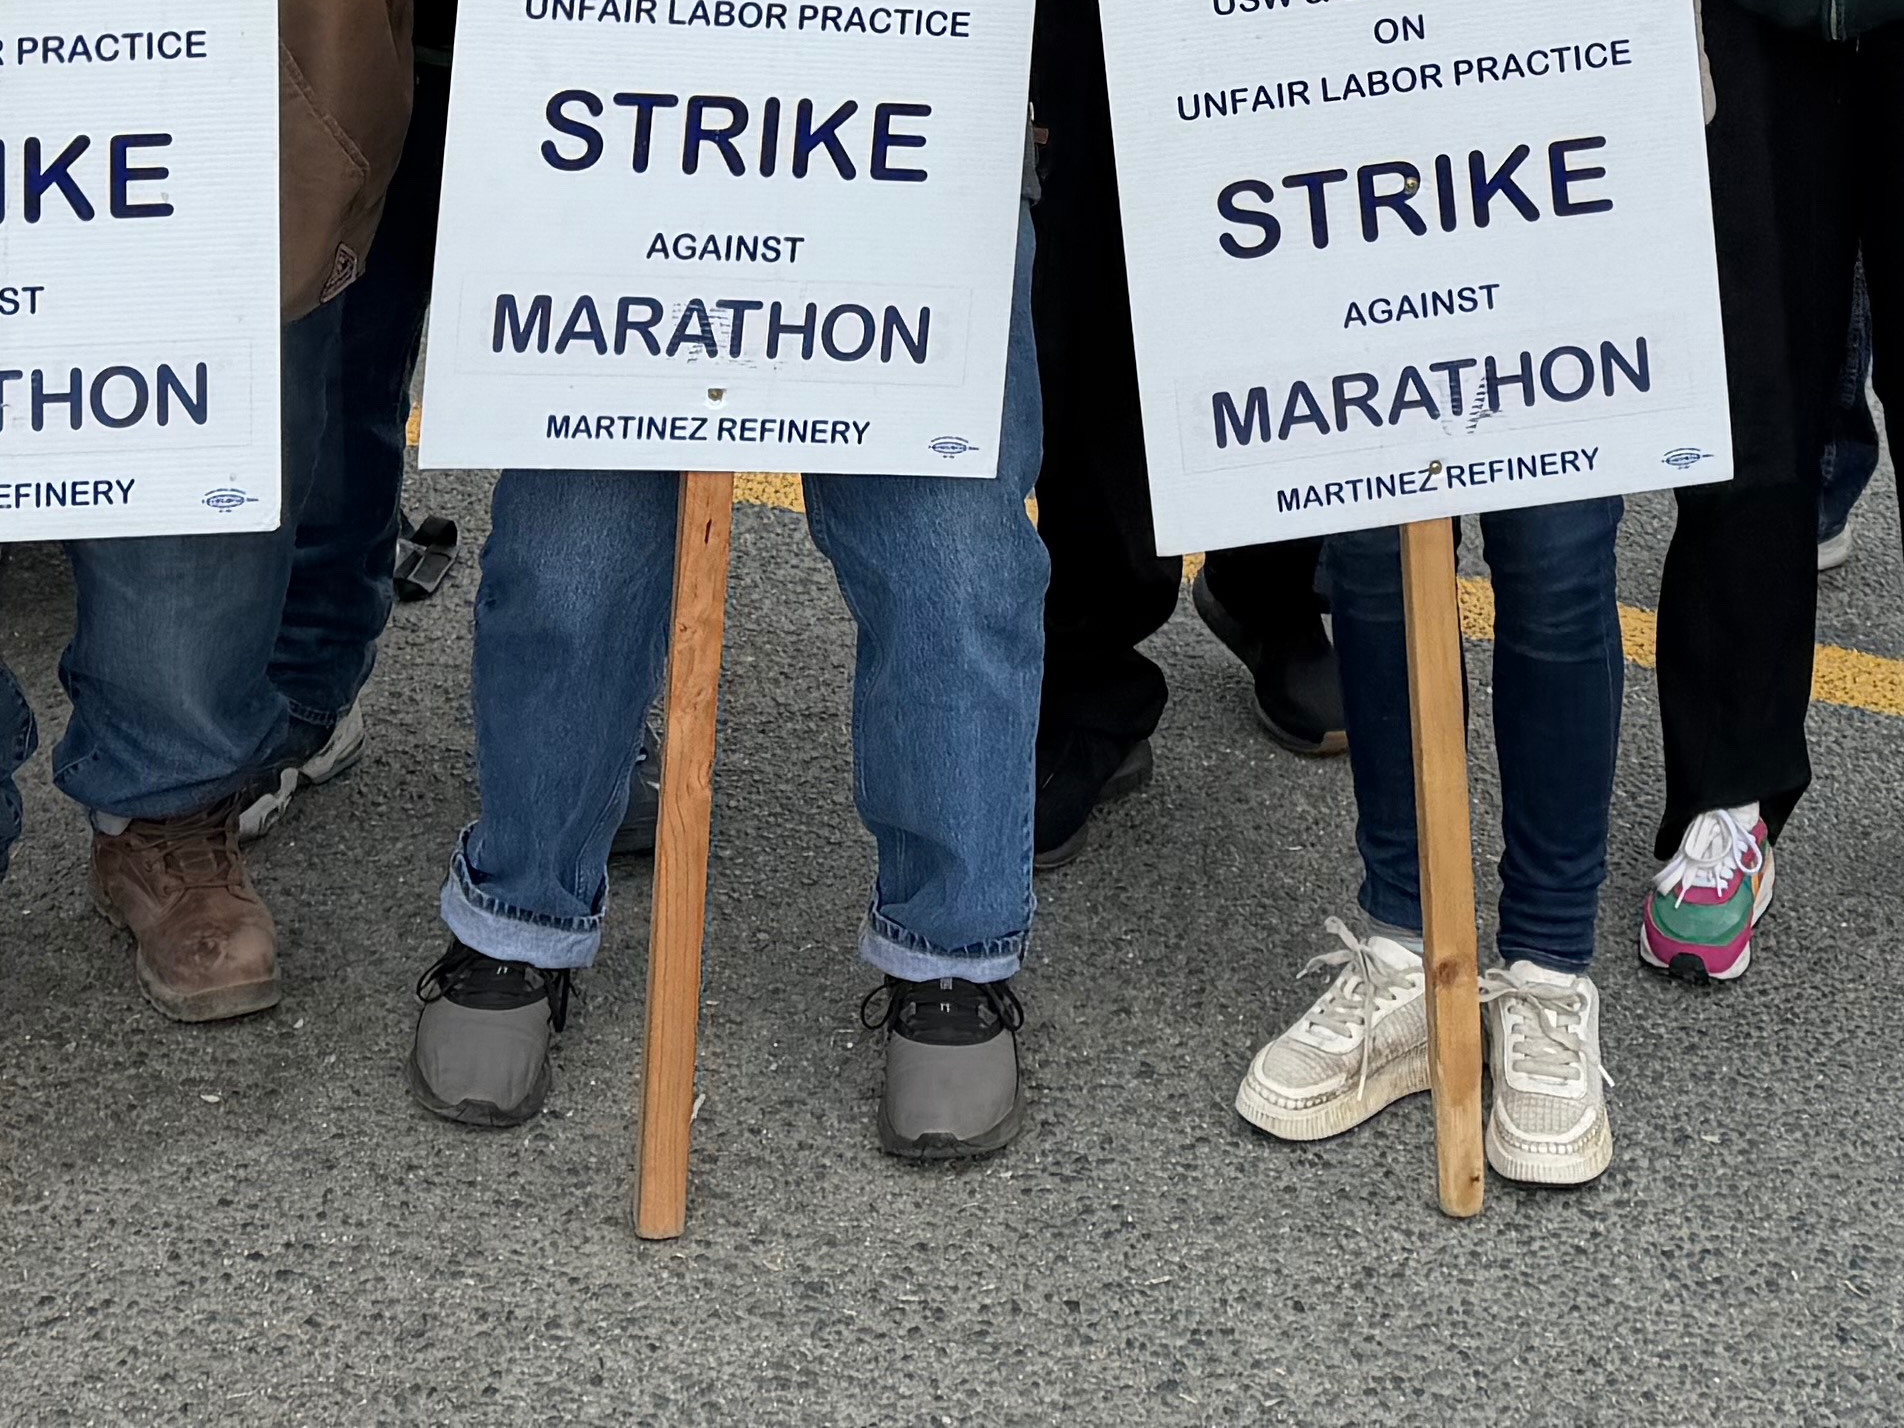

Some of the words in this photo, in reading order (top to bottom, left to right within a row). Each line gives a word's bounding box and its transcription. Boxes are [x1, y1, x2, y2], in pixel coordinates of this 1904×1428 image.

[18, 31, 207, 65] PRACTICE
[799, 5, 970, 37] PRACTICE
[1374, 14, 1424, 44] ON
[1178, 81, 1310, 120] UNFAIR
[1321, 64, 1442, 102] LABOR
[1454, 39, 1632, 86] PRACTICE
[541, 90, 932, 182] STRIKE
[1217, 136, 1613, 259] STRIKE
[646, 233, 804, 263] AGAINST
[493, 294, 930, 364] MARATHON
[1344, 284, 1500, 328] AGAINST
[1212, 337, 1650, 449] MARATHON
[546, 414, 707, 442] MARTINEZ
[717, 418, 870, 445] REFINERY
[1276, 468, 1436, 512] MARTINEZ
[1446, 447, 1598, 489] REFINERY
